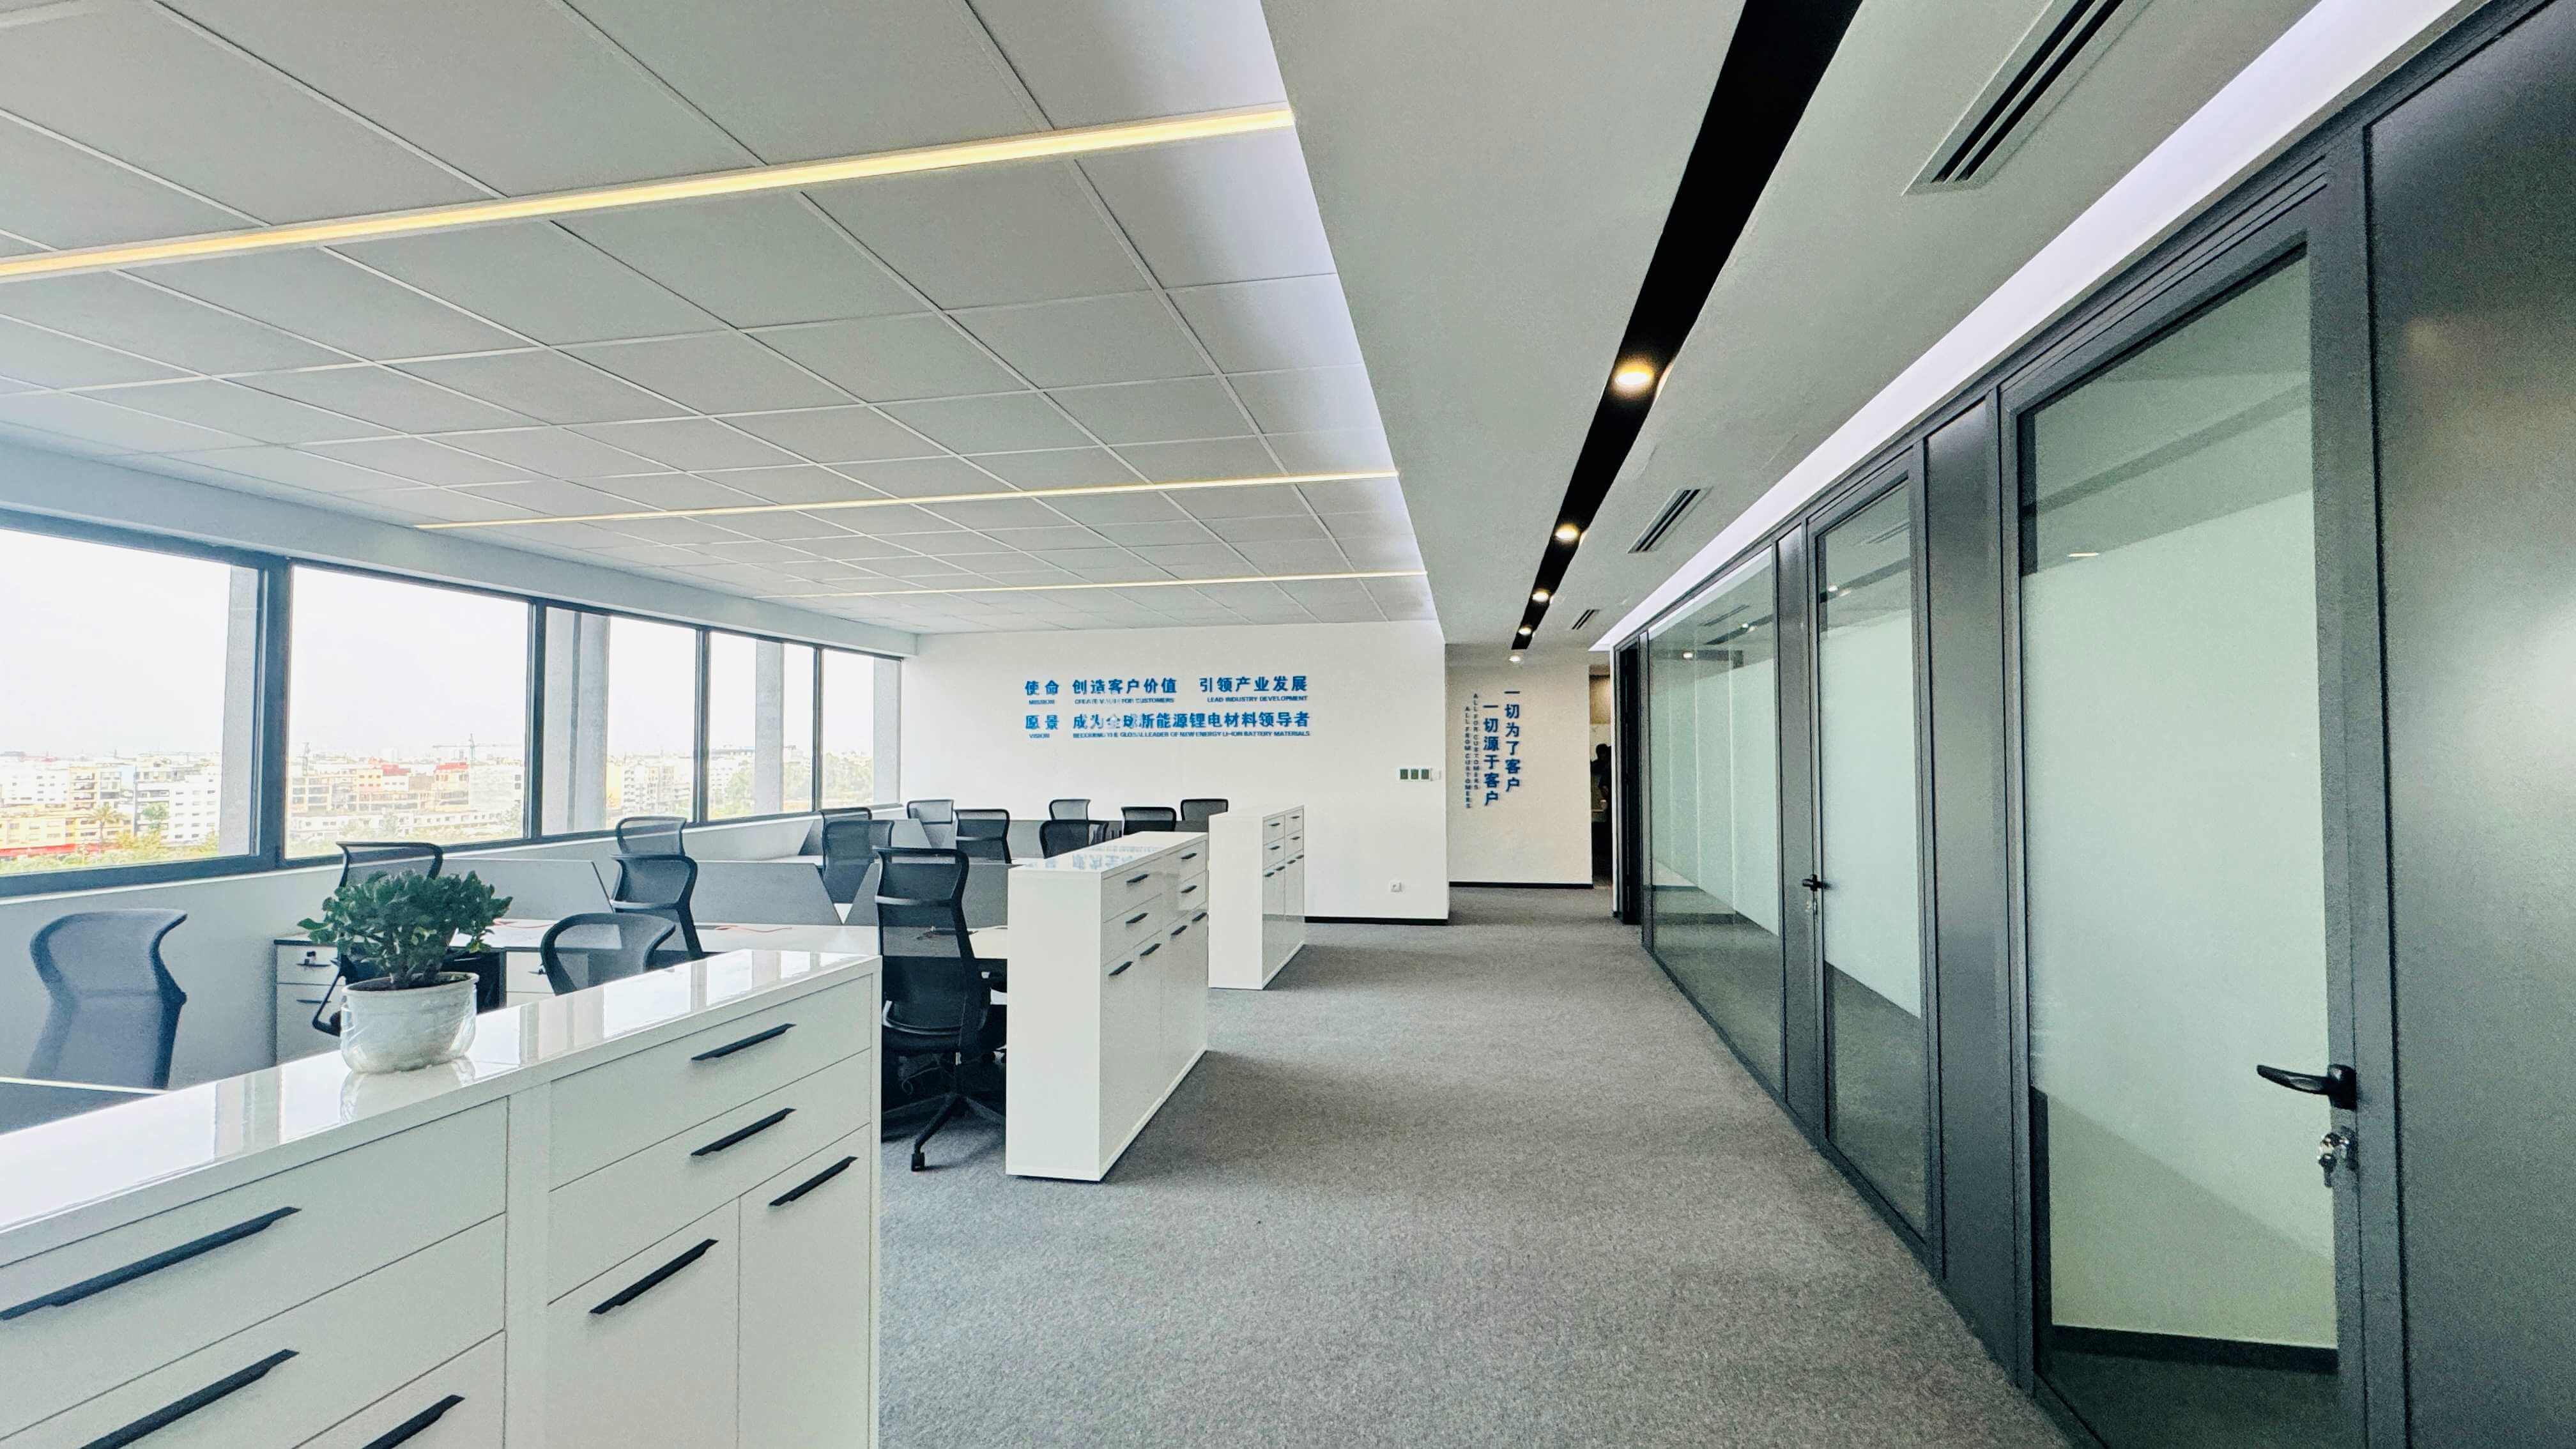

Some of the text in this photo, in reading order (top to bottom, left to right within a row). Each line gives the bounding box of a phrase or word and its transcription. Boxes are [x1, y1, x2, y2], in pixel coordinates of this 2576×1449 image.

[1025, 680, 1059, 695] 使命
[1073, 675, 1308, 694] 创造客户价值 引领产业发展
[1483, 705, 1499, 806] 一切源于客户
[1504, 691, 1521, 792] 一切为了客户
